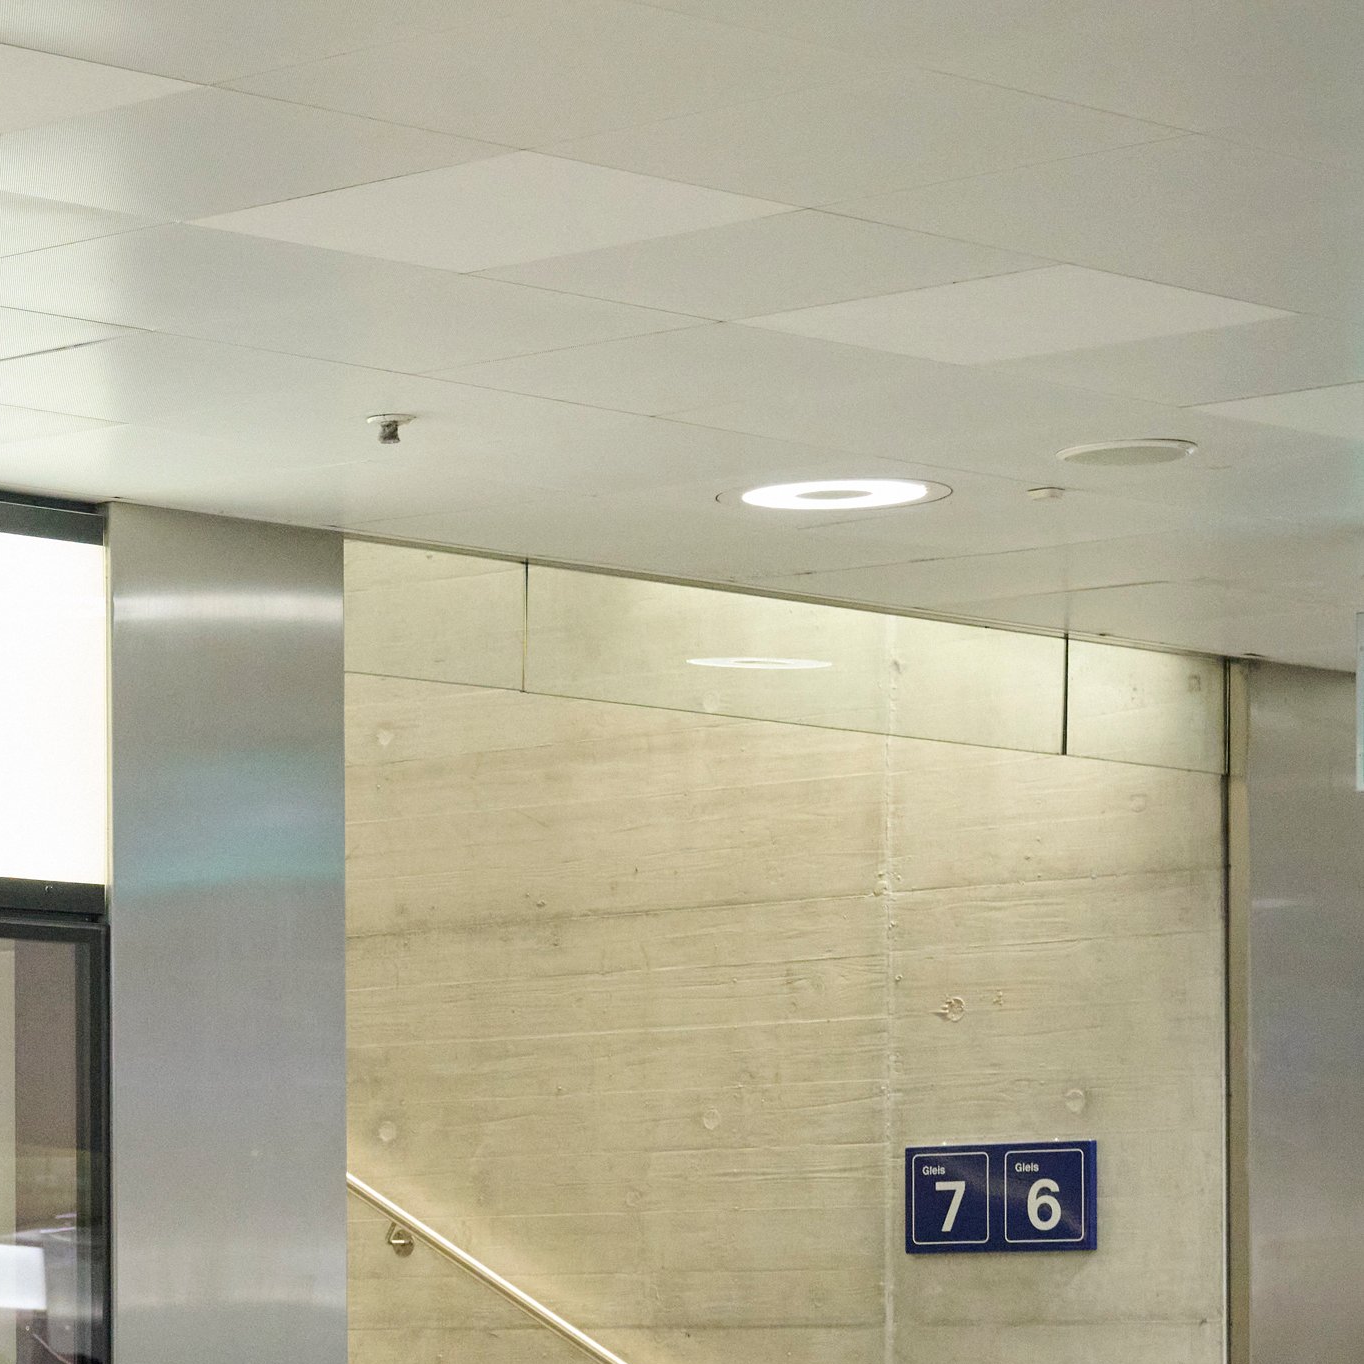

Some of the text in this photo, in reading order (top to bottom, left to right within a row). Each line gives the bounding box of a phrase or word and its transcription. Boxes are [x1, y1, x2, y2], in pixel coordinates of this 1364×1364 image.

[922, 1165, 945, 1176] Gleis
[1015, 1163, 1039, 1173] Gleis
[935, 1181, 965, 1232] 7
[1027, 1178, 1061, 1231] 6
